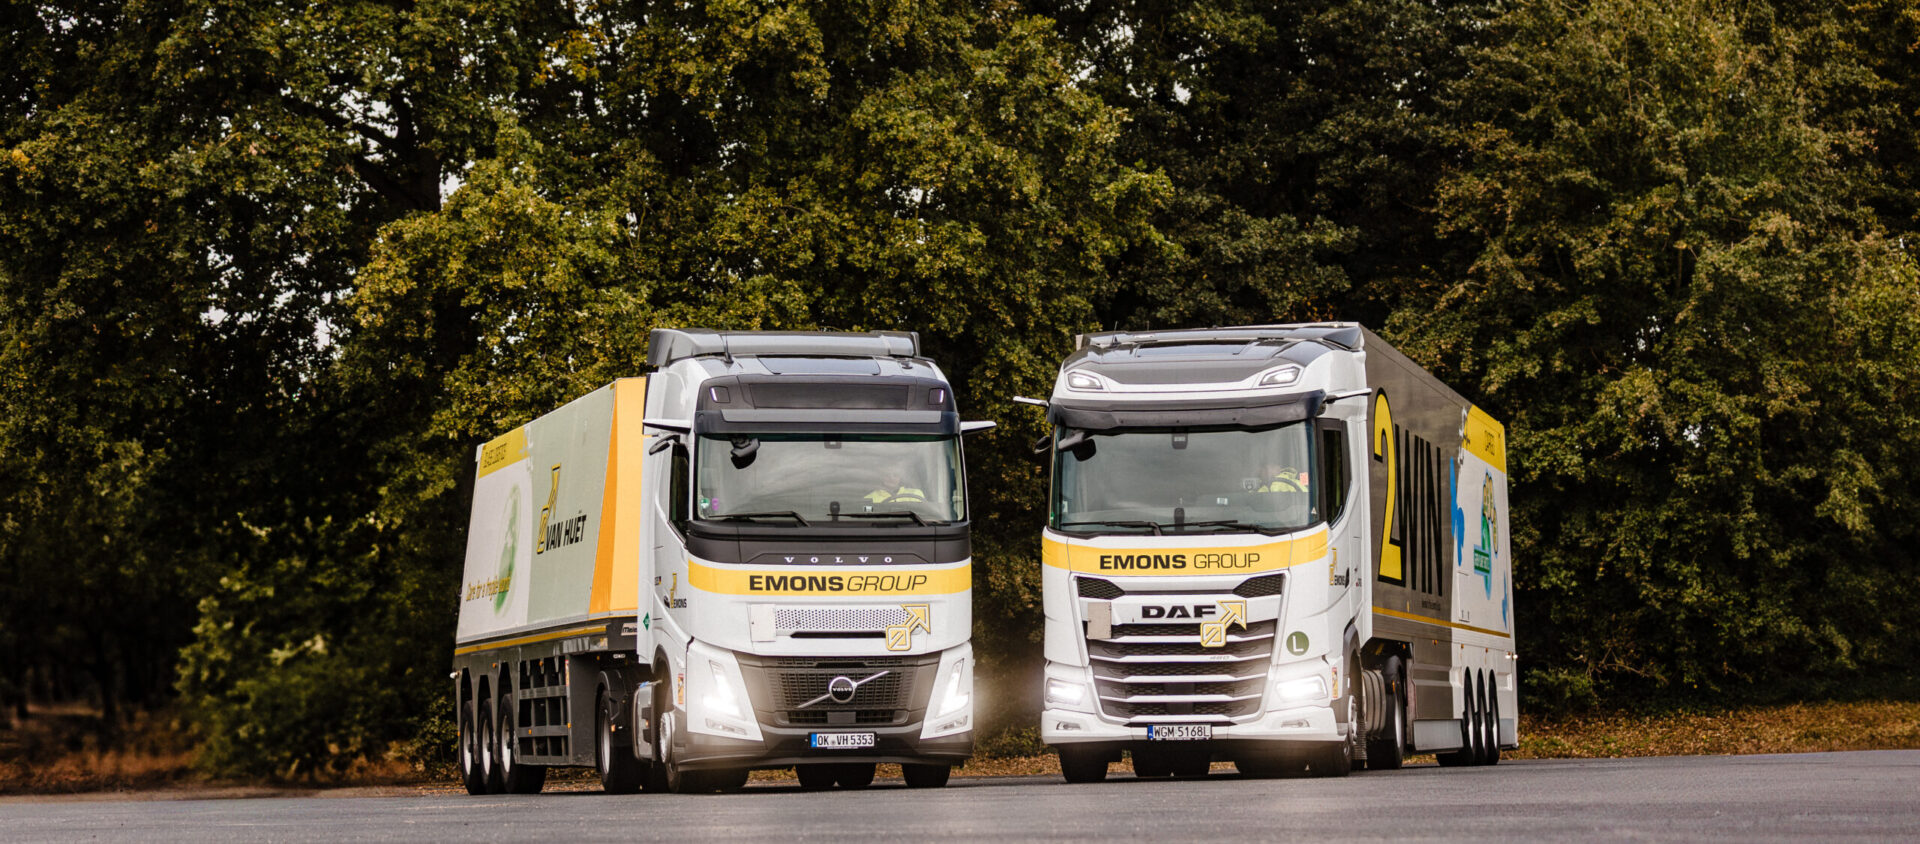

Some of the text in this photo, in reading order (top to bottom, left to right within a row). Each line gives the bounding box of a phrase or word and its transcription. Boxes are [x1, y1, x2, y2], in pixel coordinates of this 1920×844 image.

[546, 521, 563, 551] VAN
[1099, 552, 1261, 570] EMONS GROUP
[749, 574, 928, 592] EMONS GROUP
[1141, 604, 1217, 619] DAF
[1292, 635, 1305, 652] L
[1154, 726, 1210, 737] WGM 5168L
[817, 735, 874, 746] OK VH 5353
